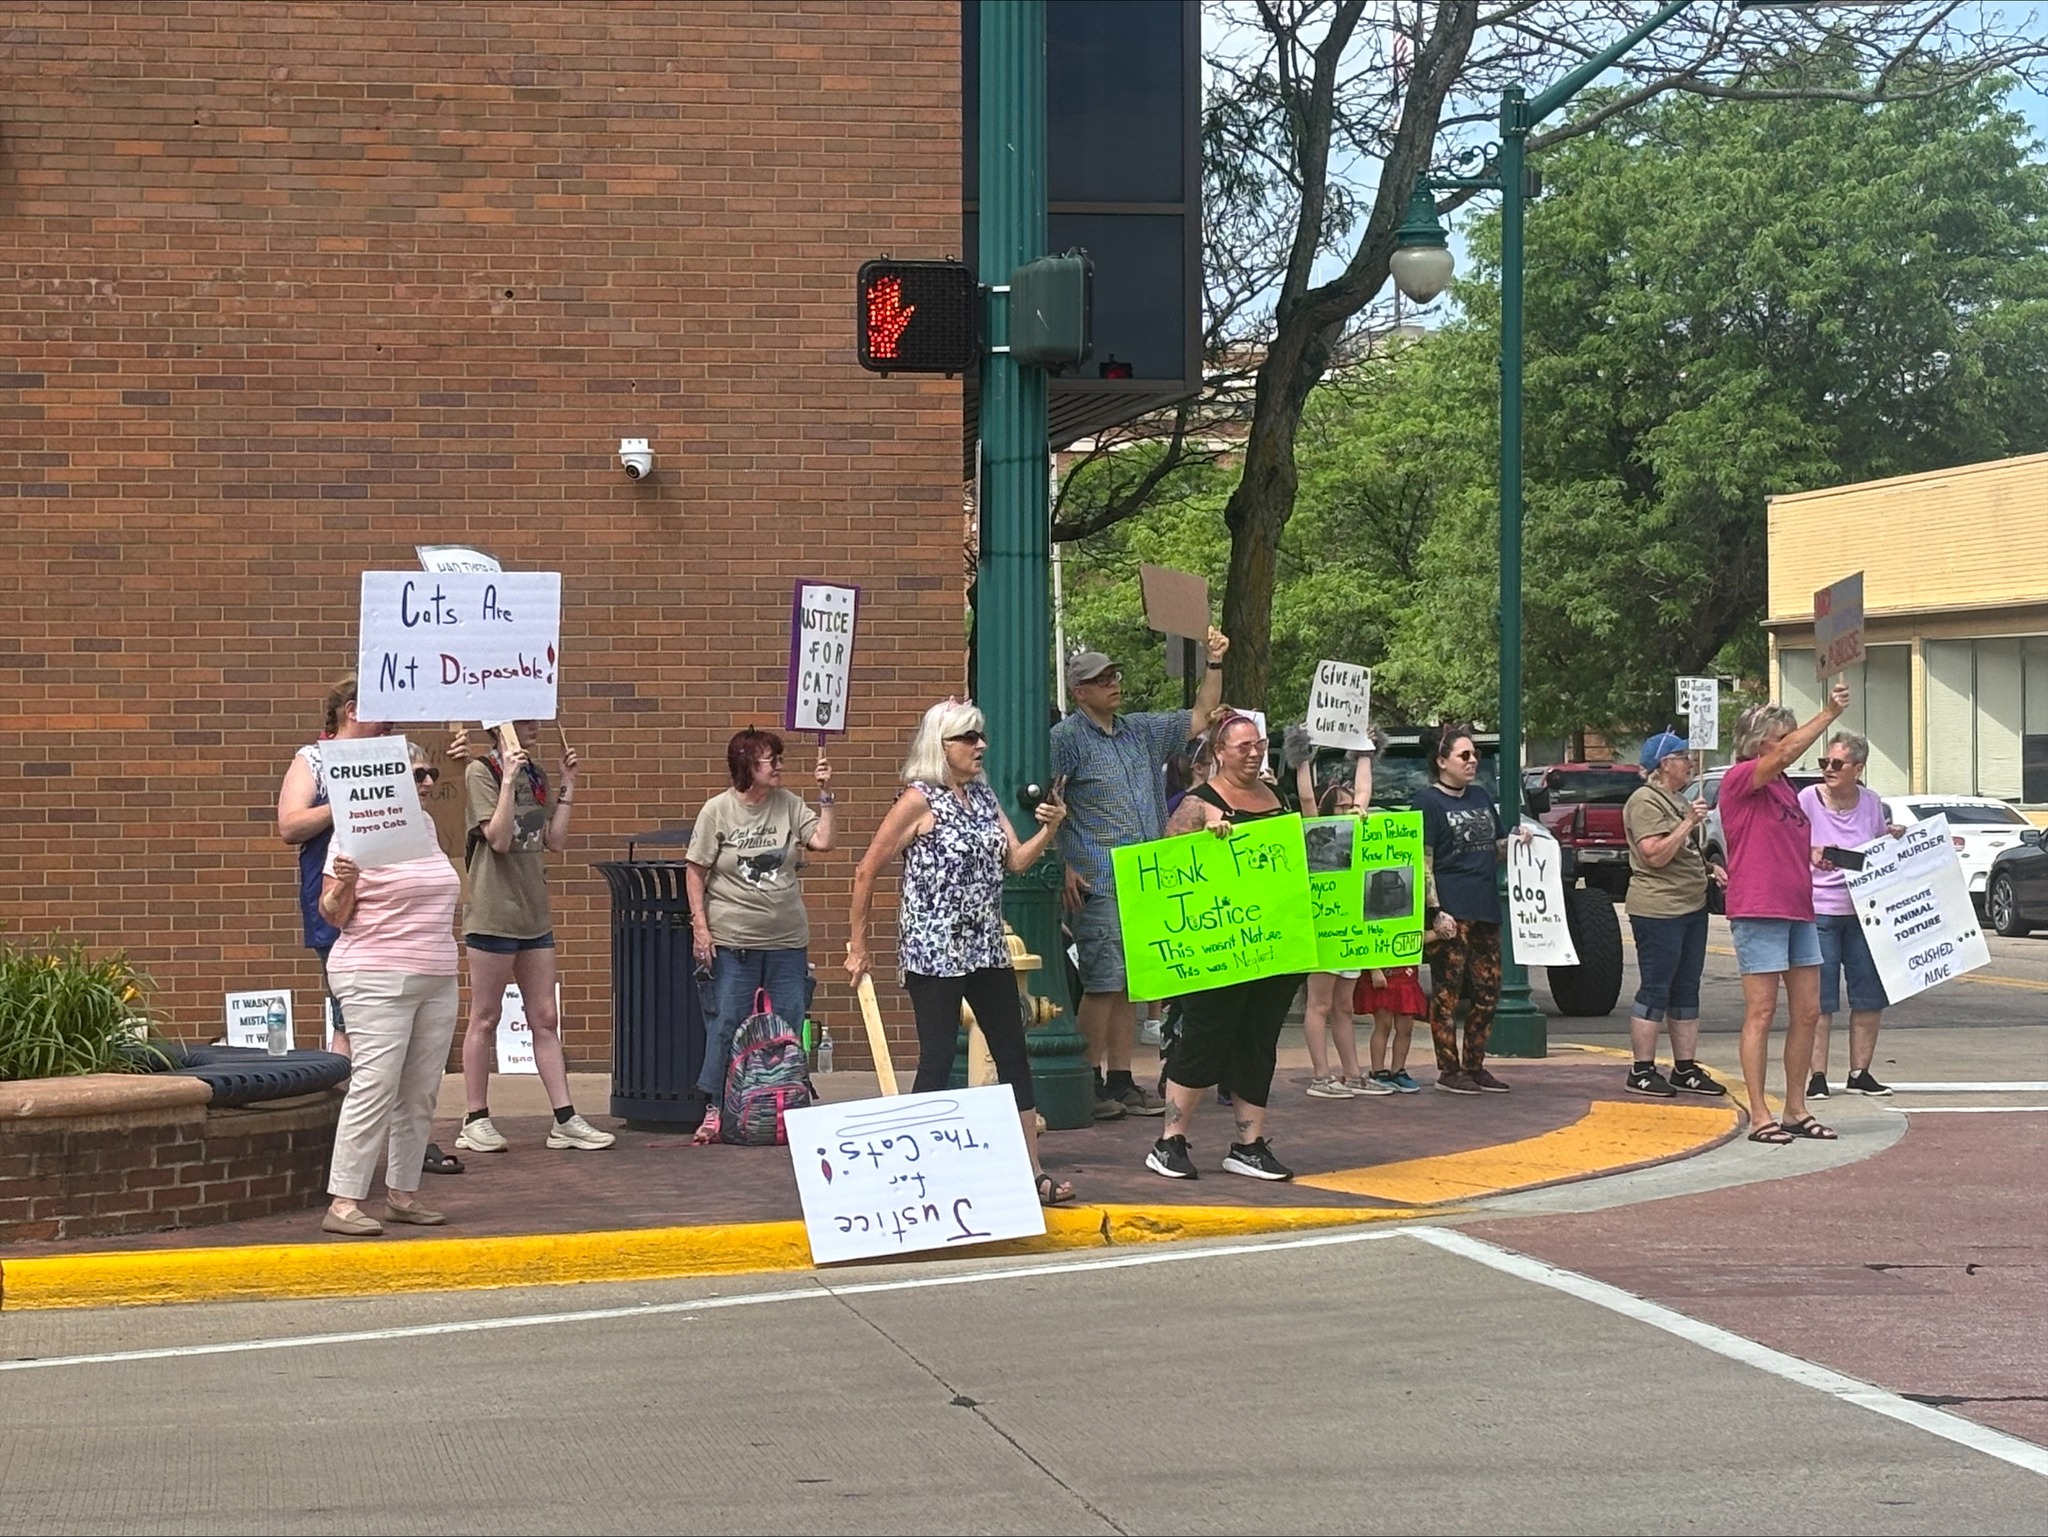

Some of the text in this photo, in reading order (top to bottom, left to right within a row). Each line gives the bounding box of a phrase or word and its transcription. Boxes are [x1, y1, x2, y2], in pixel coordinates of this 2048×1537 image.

[402, 580, 514, 628] Cats Are
[800, 607, 849, 633] USTICE
[809, 641, 844, 665] FOR
[380, 641, 555, 692] Not Disposable!
[802, 670, 843, 698] CATS
[330, 762, 406, 779] CRUSHED
[349, 785, 396, 801] ALIVE
[387, 806, 404, 816] for
[382, 819, 407, 829] Cats
[1906, 828, 1928, 844] IT'S
[1864, 842, 1886, 858] NOT
[1897, 834, 1946, 862] MURDER
[1848, 862, 1898, 889] MISTAKE
[1866, 861, 1874, 870] A
[1512, 868, 1547, 914] dog
[1164, 891, 1262, 933] Justice
[1517, 910, 1538, 924] told
[1893, 902, 1934, 926] ANIMAL
[1894, 914, 1942, 942] TORTURE
[1148, 939, 1195, 962] This
[1908, 942, 1954, 970] CRUSHED
[1166, 963, 1200, 979] This
[1206, 963, 1228, 973] was
[1924, 963, 1951, 987] ALIVE
[232, 1000, 240, 1010] IT
[510, 1021, 529, 1032] Cr
[889, 1172, 926, 1198] for
[834, 1198, 991, 1243] Justice
